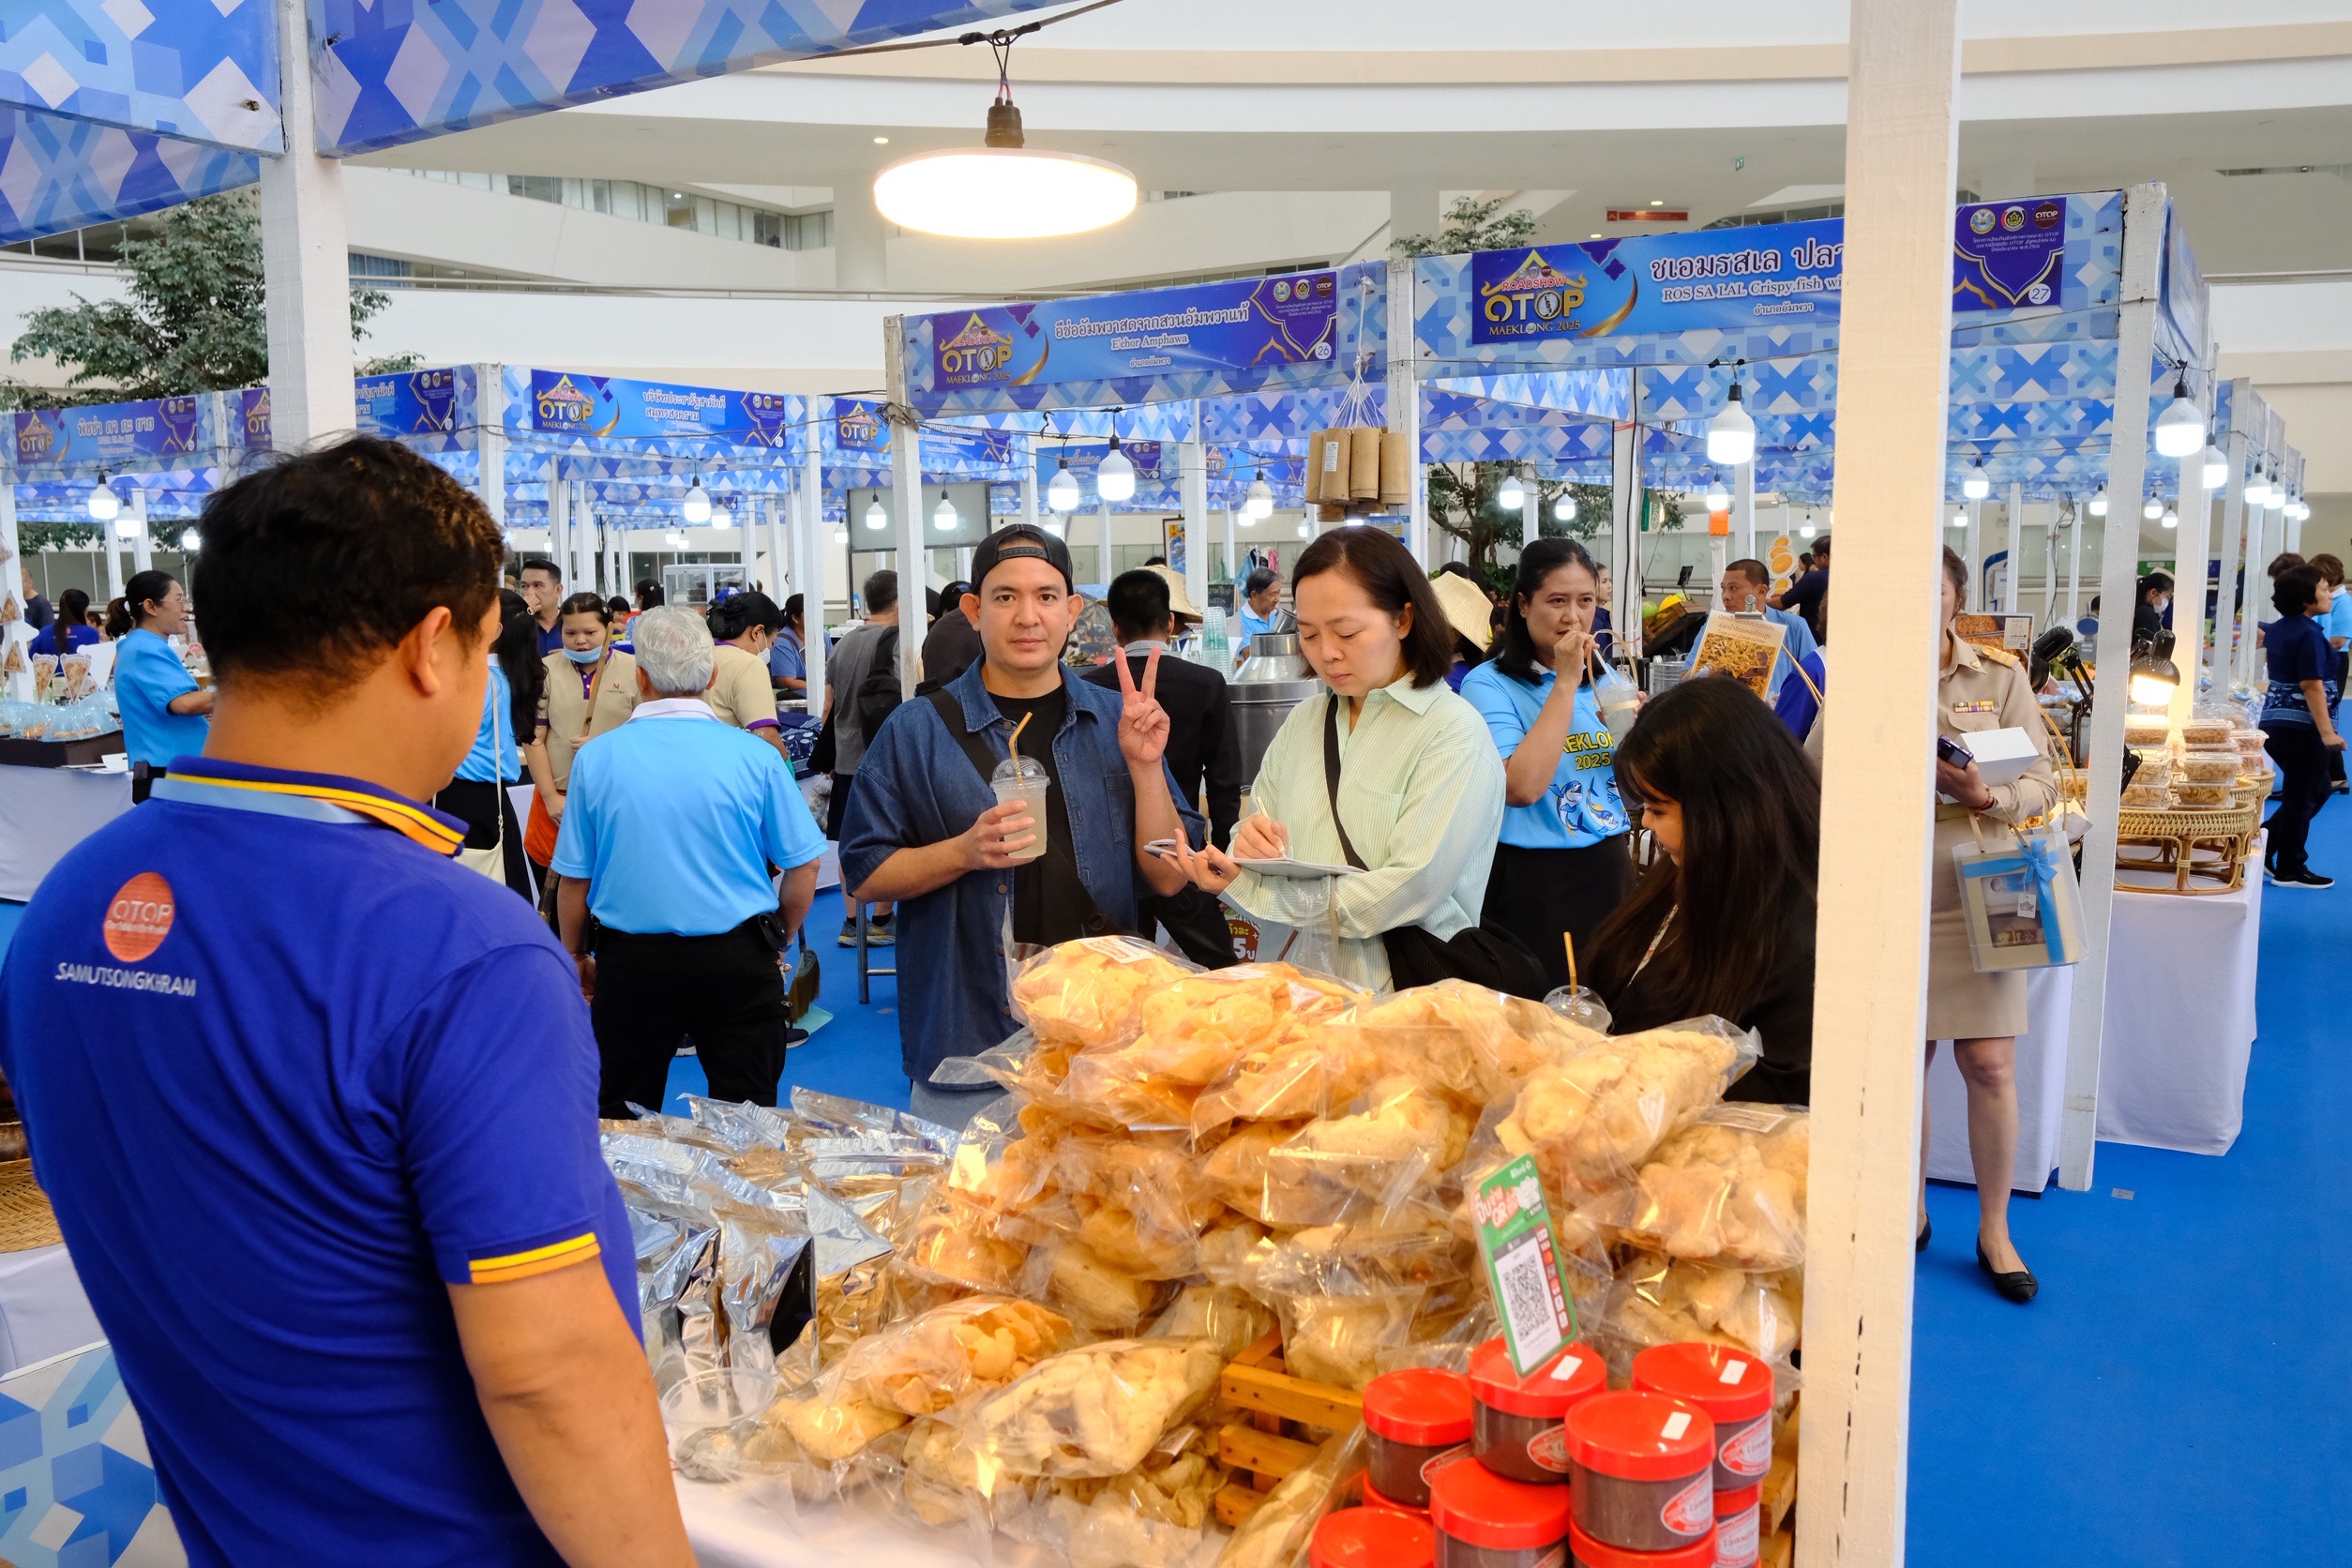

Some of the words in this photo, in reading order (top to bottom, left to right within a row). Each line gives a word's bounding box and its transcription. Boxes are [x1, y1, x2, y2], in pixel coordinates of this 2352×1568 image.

[2035, 210, 2058, 219] OTOP
[1501, 276, 1566, 292] ROADSHOW
[1662, 287, 1692, 303] ROS
[1695, 285, 1716, 301] SA
[1717, 281, 1748, 297] LAL
[2030, 287, 2049, 300] 27
[1485, 289, 1585, 322] OTOP
[1753, 301, 1815, 316] อำเภออัมพวา
[1488, 322, 1554, 336] MAEKLONG
[1557, 320, 1581, 331] 2025
[953, 334, 999, 348] ROADSHOW
[1141, 333, 1189, 350] Amphawa
[942, 345, 1013, 373] OTOP
[1318, 345, 1330, 356] 26
[946, 372, 991, 384] MAEKLONG
[993, 370, 1011, 381] 2025
[539, 400, 594, 422] OTOP
[248, 415, 271, 433] OT
[542, 420, 578, 430] MAEKLONG
[840, 422, 878, 441] OTOP
[20, 434, 53, 453] OTOP
[1575, 752, 1611, 771] 2025
[112, 899, 173, 923] OTOP
